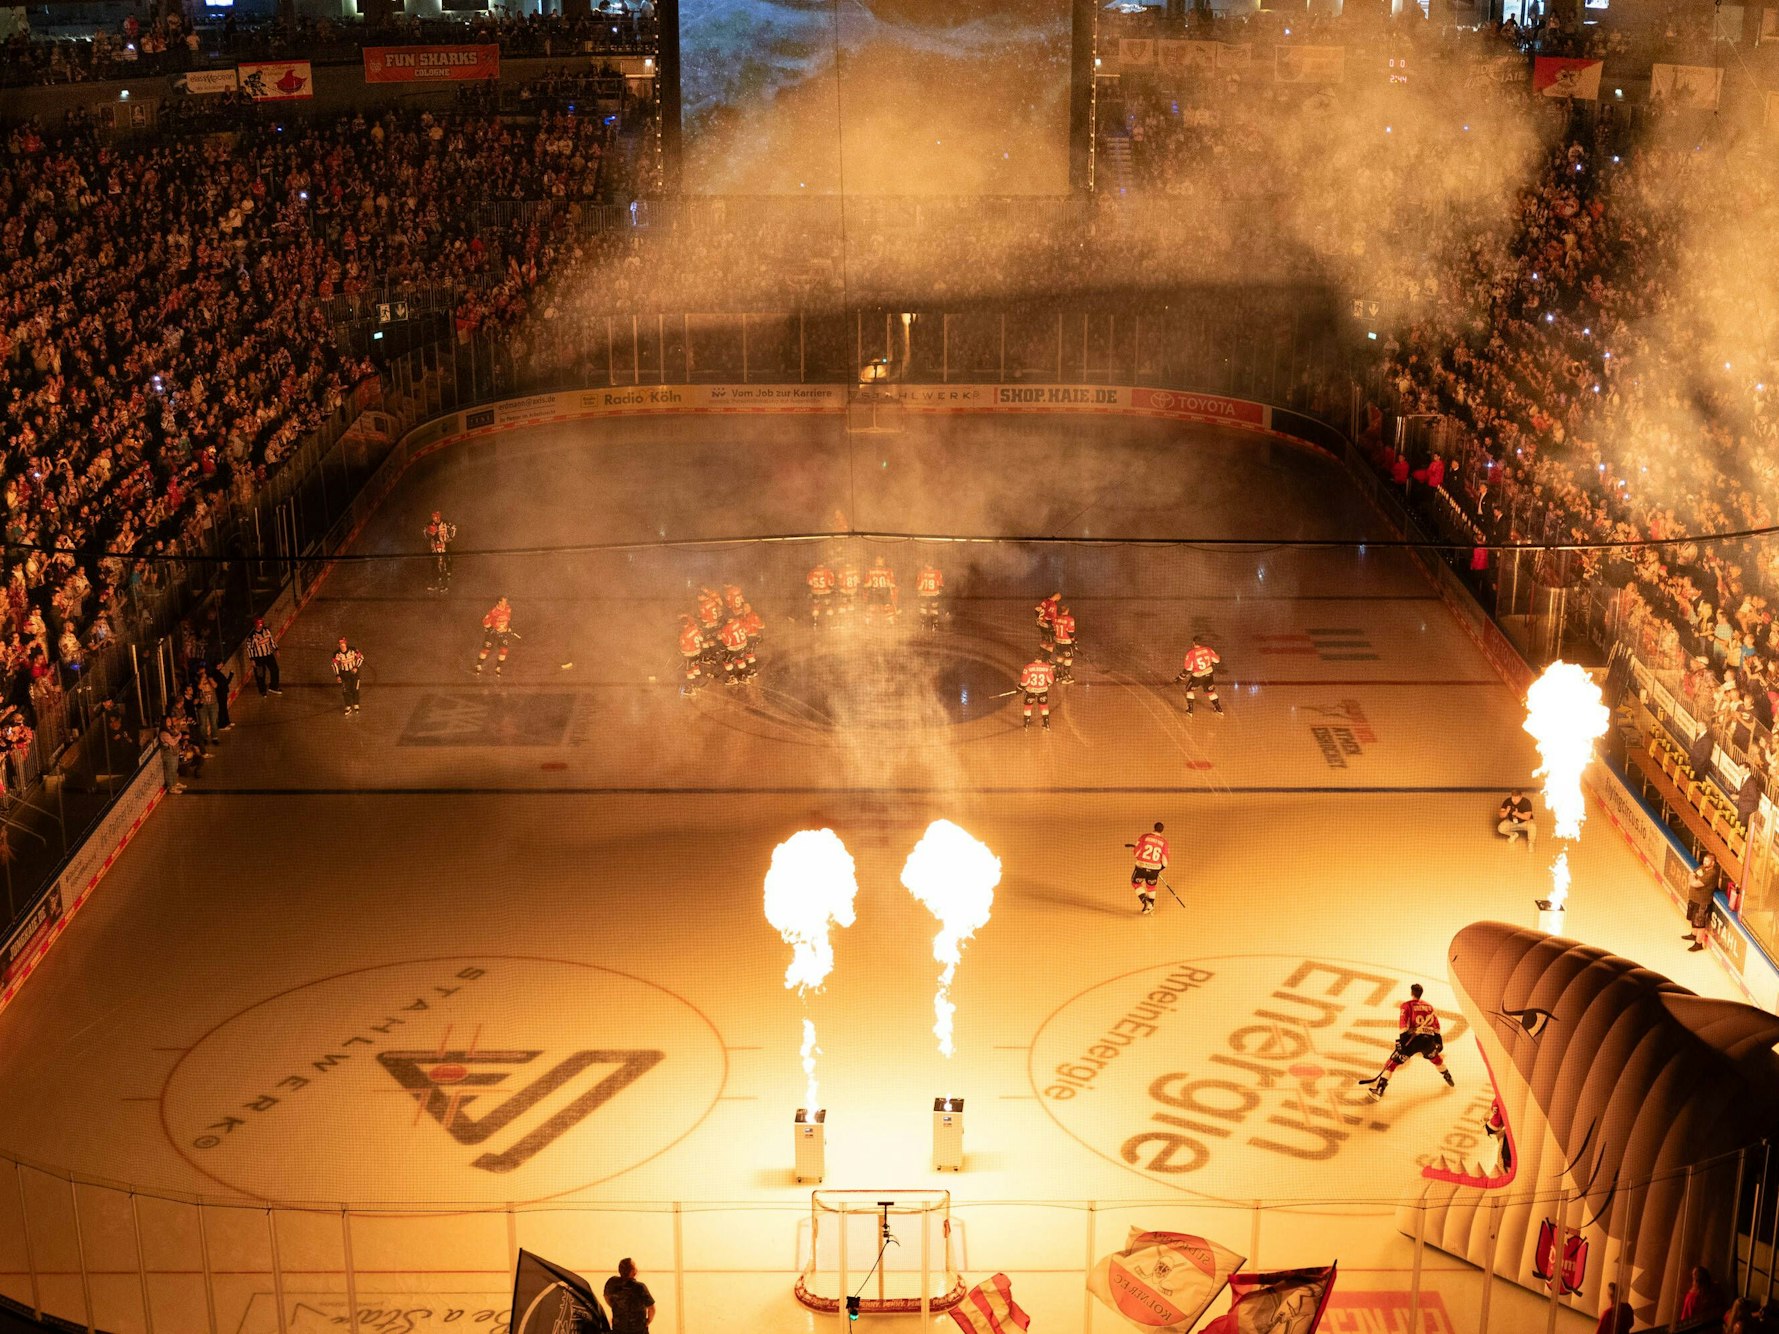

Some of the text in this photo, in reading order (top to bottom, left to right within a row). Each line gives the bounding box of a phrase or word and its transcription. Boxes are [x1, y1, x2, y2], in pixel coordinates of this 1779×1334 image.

[385, 52, 478, 67] FUN SHARKS
[414, 68, 450, 77] COLOGNE
[604, 392, 644, 406] Radio
[650, 390, 682, 404] Köln
[731, 388, 832, 398] Vom Job zur Karriere
[1000, 388, 1118, 404] SHOP.HAIE.DE
[1178, 396, 1236, 416] TOYOTA
[1030, 673, 1046, 687] 33
[1142, 844, 1162, 862] 26
[1710, 911, 1739, 959] STAHL
[1043, 964, 1216, 1102] RheinEnergie
